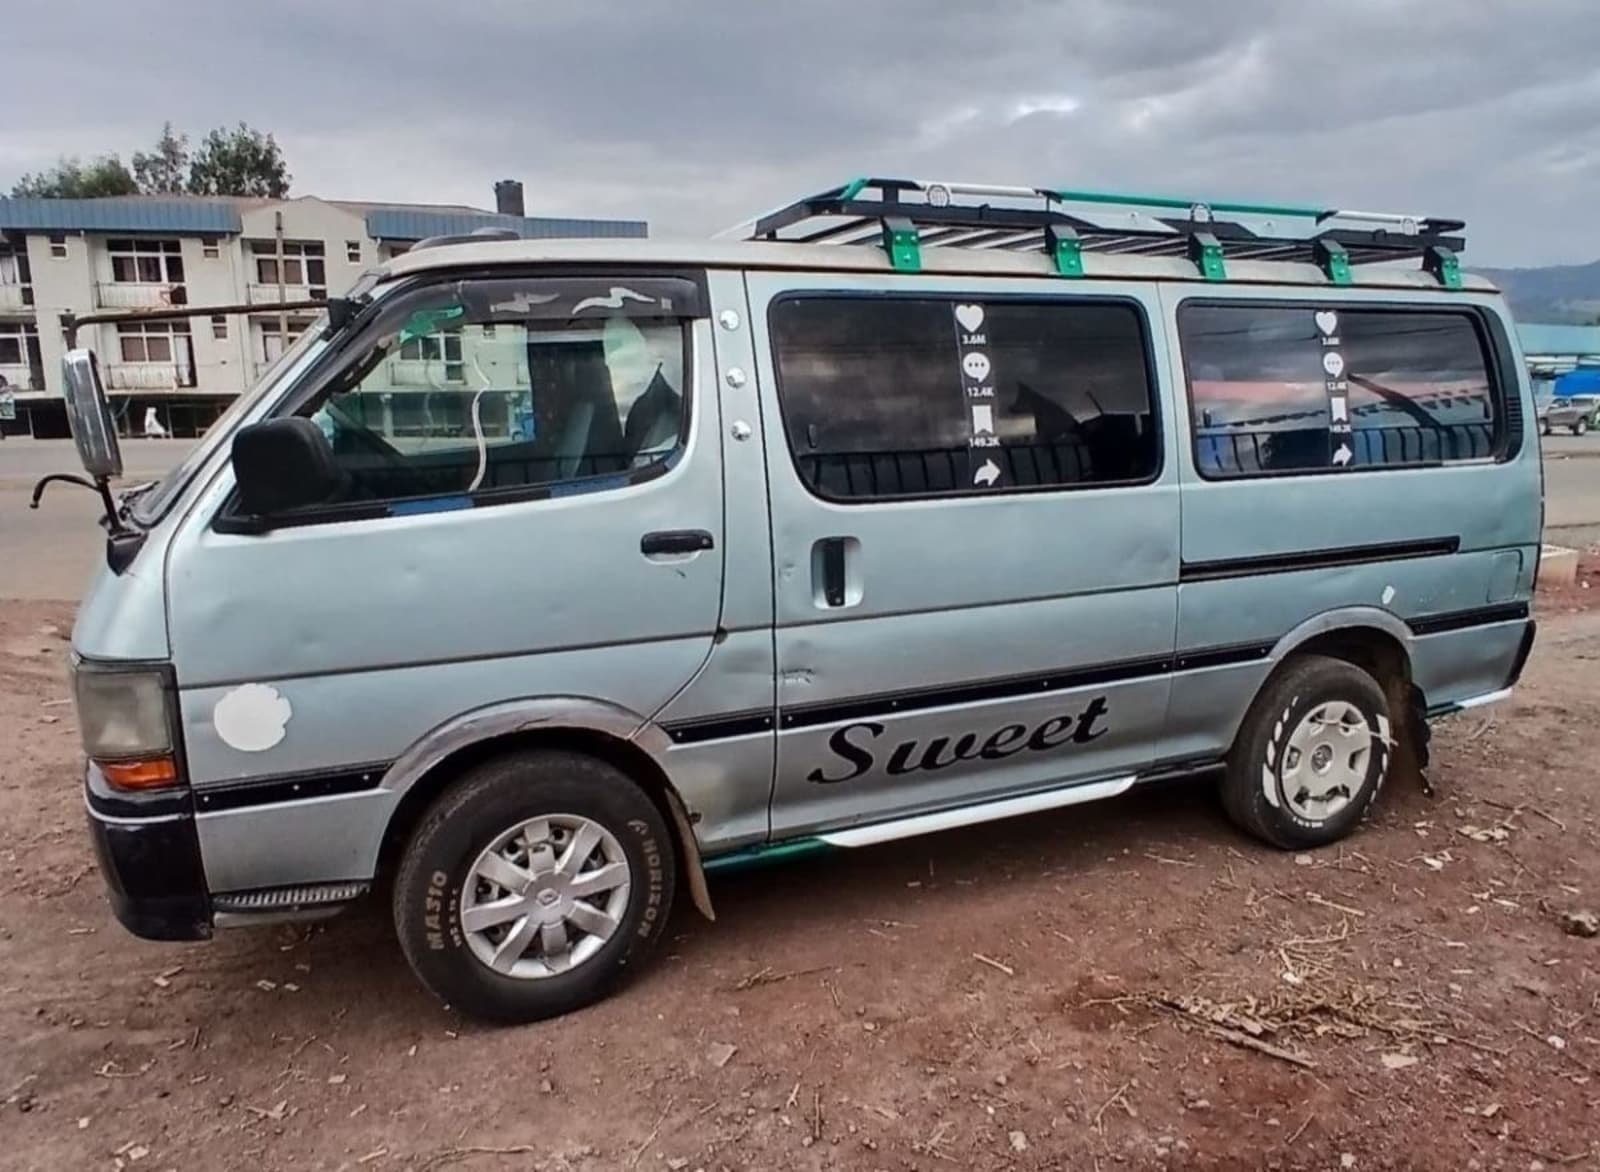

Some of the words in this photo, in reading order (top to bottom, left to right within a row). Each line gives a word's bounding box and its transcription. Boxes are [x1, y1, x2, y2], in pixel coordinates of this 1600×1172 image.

[967, 387, 994, 397] 12.4K
[969, 436, 1000, 448] 149.2K
[807, 696, 1108, 784] Sweet
[637, 839, 663, 937] HORIZON
